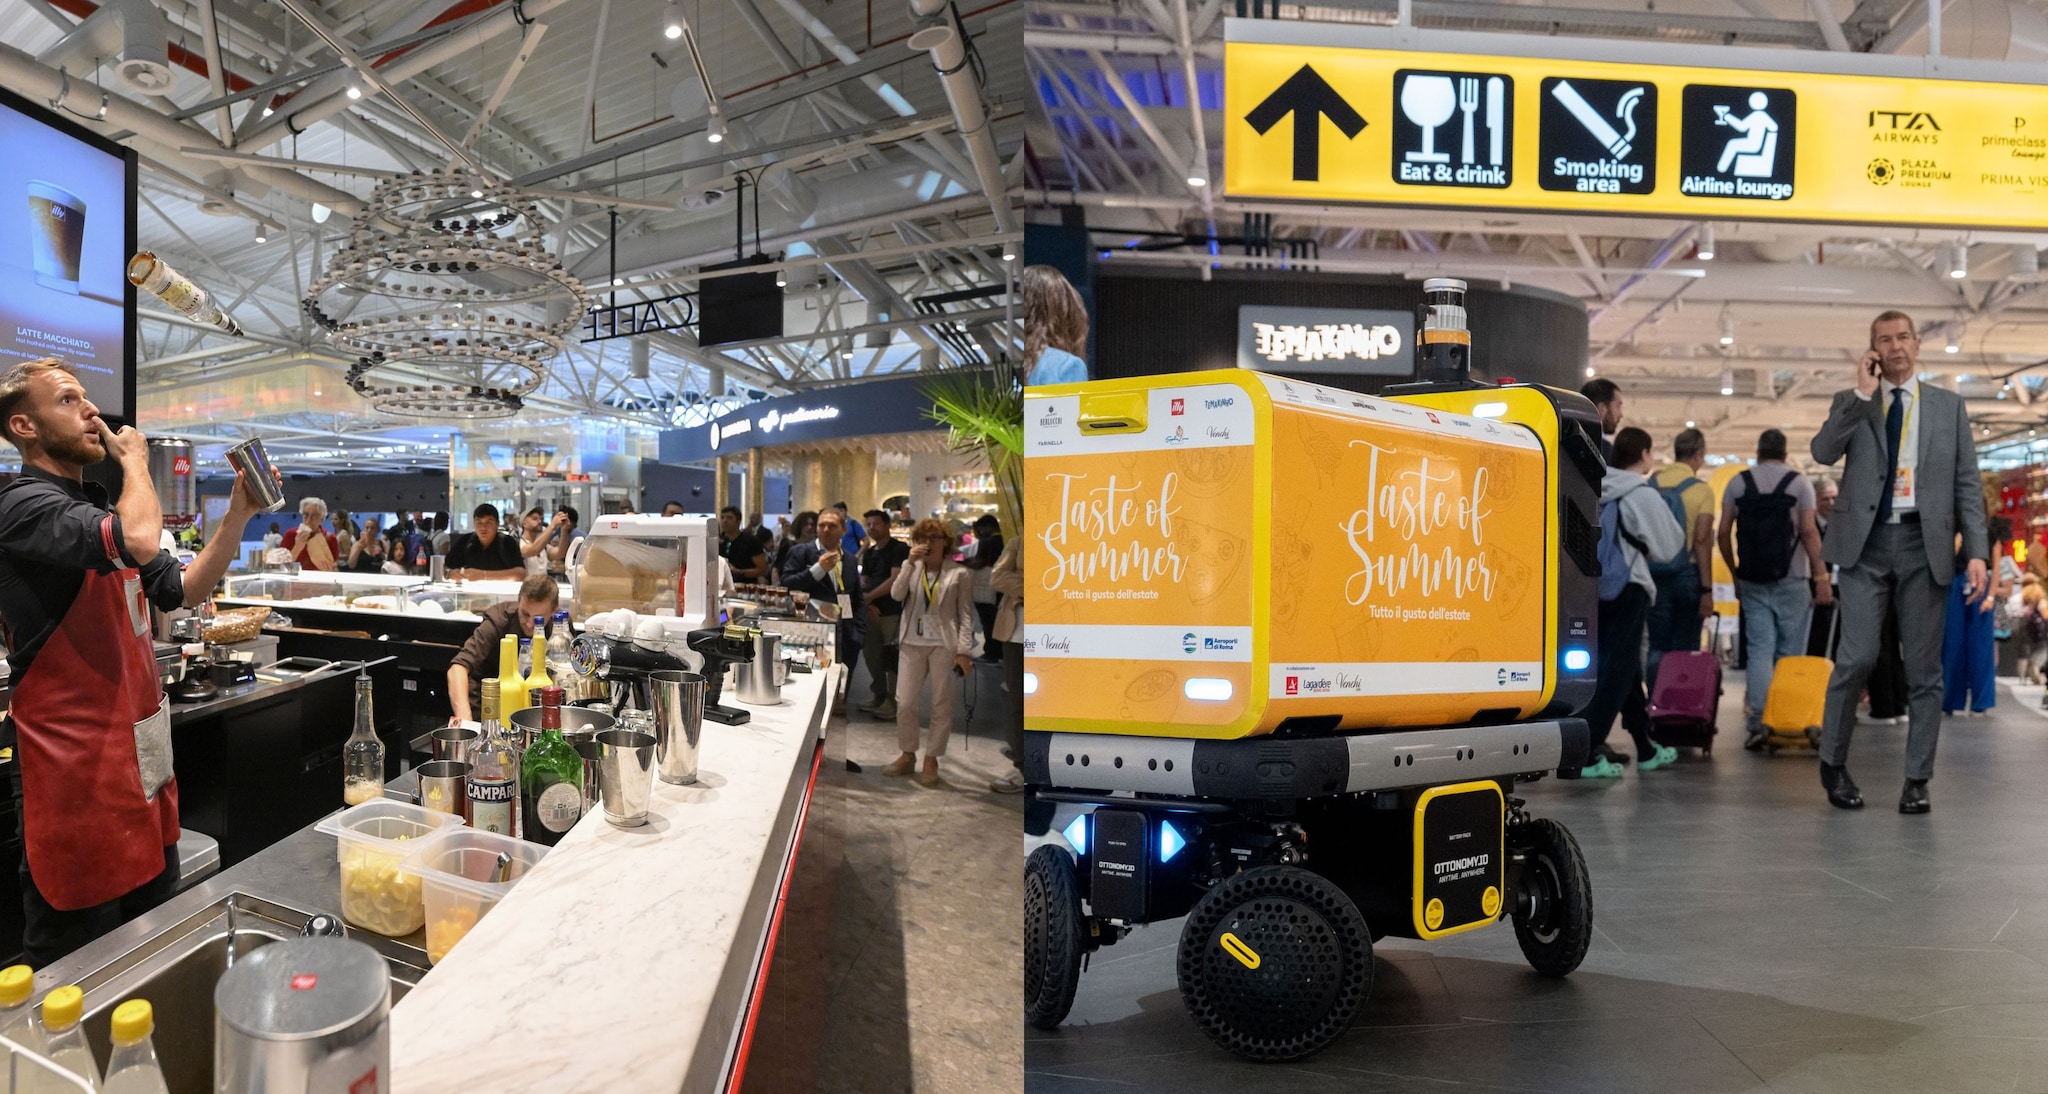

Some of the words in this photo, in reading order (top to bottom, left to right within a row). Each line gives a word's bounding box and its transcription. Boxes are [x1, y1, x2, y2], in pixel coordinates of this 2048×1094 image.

[1868, 111, 1942, 130] ITA
[1873, 132, 1939, 144] AIRWAYS
[1982, 134, 2046, 147] primeclass
[1554, 157, 1643, 183] Smoking
[1901, 159, 1936, 168] PLAZA
[1400, 162, 1431, 181] Eat
[1433, 163, 1452, 183] &
[1456, 165, 1506, 184] drink
[1901, 170, 1951, 179] PREMIUM
[1981, 174, 2023, 185] PRIMA
[1576, 177, 1621, 193] area
[1681, 176, 1735, 194] Airline
[1736, 178, 1792, 200] lounge
[52, 205, 64, 218] illy
[17, 327, 42, 339] LATTE
[44, 333, 90, 349] MACCHIATO
[1252, 322, 1401, 361] TEMAKINHO
[1172, 401, 1184, 414] illy
[1205, 398, 1233, 409] TEMAKINHO
[1040, 417, 1062, 427] BERLUCCHI
[1207, 425, 1230, 438] Venchi
[175, 459, 190, 474] illy
[1349, 440, 1454, 542] Taste
[1459, 467, 1491, 546] of
[1046, 473, 1141, 544] Taste
[1146, 472, 1182, 538] of
[1037, 522, 1189, 591] Summer
[1339, 509, 1498, 606] Summer
[1062, 589, 1083, 599] Tutto
[1086, 589, 1091, 599] il
[1092, 590, 1115, 602] gusto
[1116, 589, 1159, 599] dell'estate
[1369, 605, 1393, 618] Tutto
[1395, 605, 1400, 618] il
[1402, 608, 1426, 622] gusto
[1429, 607, 1470, 620] dell'estate
[1041, 634, 1070, 650] Venchi
[1336, 672, 1362, 688] Venchi
[467, 783, 515, 800] CAMPARI
[1099, 861, 1135, 871] OTTONOMY.IO
[1434, 854, 1488, 875] OTTONOMY.IO
